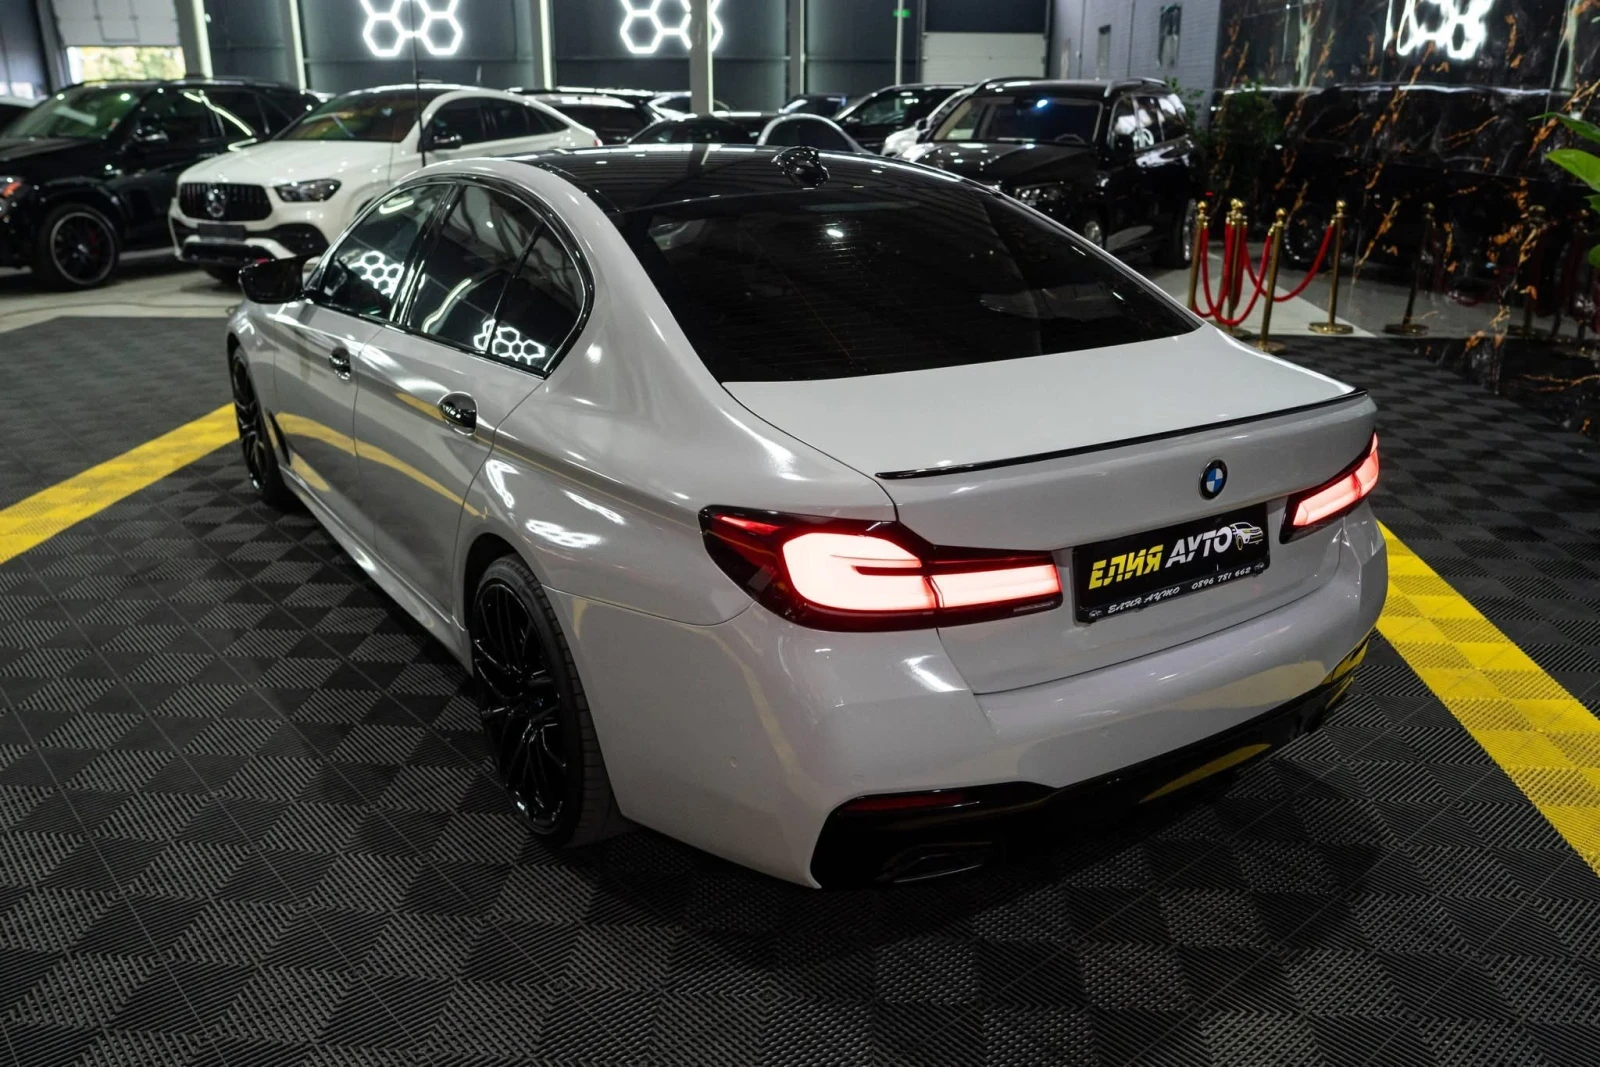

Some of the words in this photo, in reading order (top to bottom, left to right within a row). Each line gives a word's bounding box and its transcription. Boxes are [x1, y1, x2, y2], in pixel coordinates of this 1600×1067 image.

[1088, 544, 1164, 590] ЕЛИЯ
[1164, 526, 1233, 568] АУТО
[1191, 577, 1215, 590] 0896
